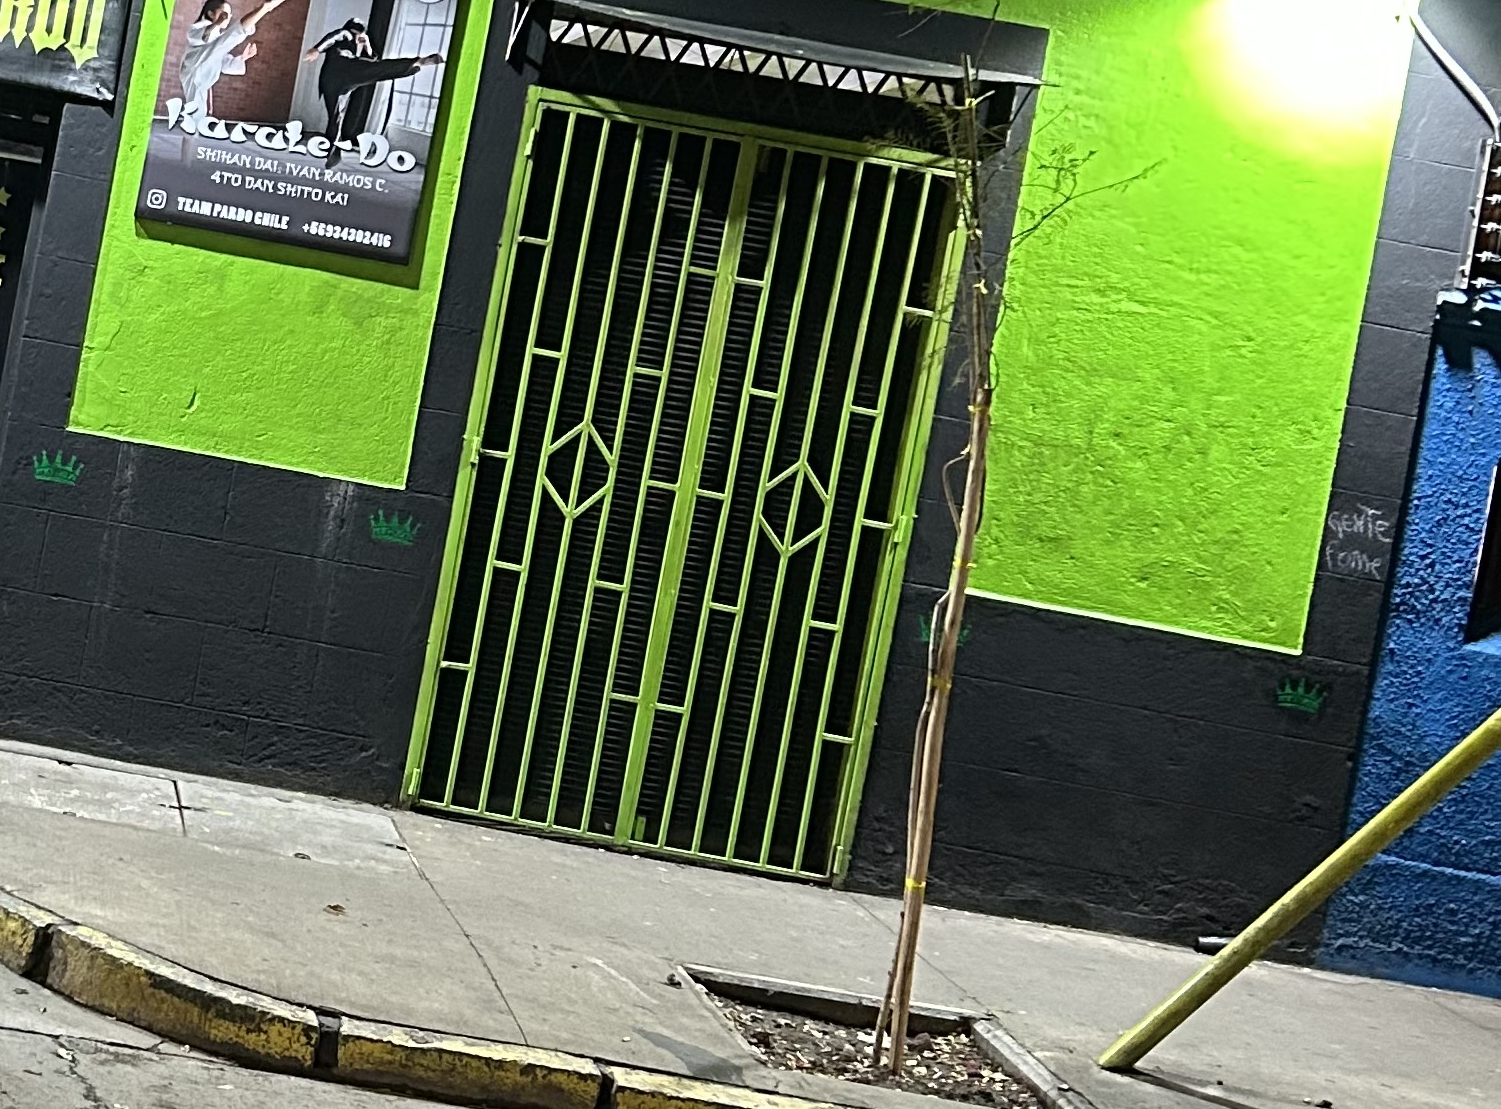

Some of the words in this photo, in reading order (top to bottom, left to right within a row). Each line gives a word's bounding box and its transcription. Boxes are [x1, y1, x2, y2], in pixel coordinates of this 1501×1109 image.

[166, 97, 417, 172] Karate-Do
[197, 146, 250, 170] SHIHAN
[286, 162, 320, 181] IVAN
[323, 168, 372, 190] RAMOS
[210, 170, 242, 188] 4TO
[245, 176, 274, 194] DAN
[276, 181, 322, 202] SHITO
[324, 190, 349, 207] KAI
[177, 196, 213, 217] TEAM
[212, 202, 253, 224] PARDO
[254, 209, 290, 230] CHILE
